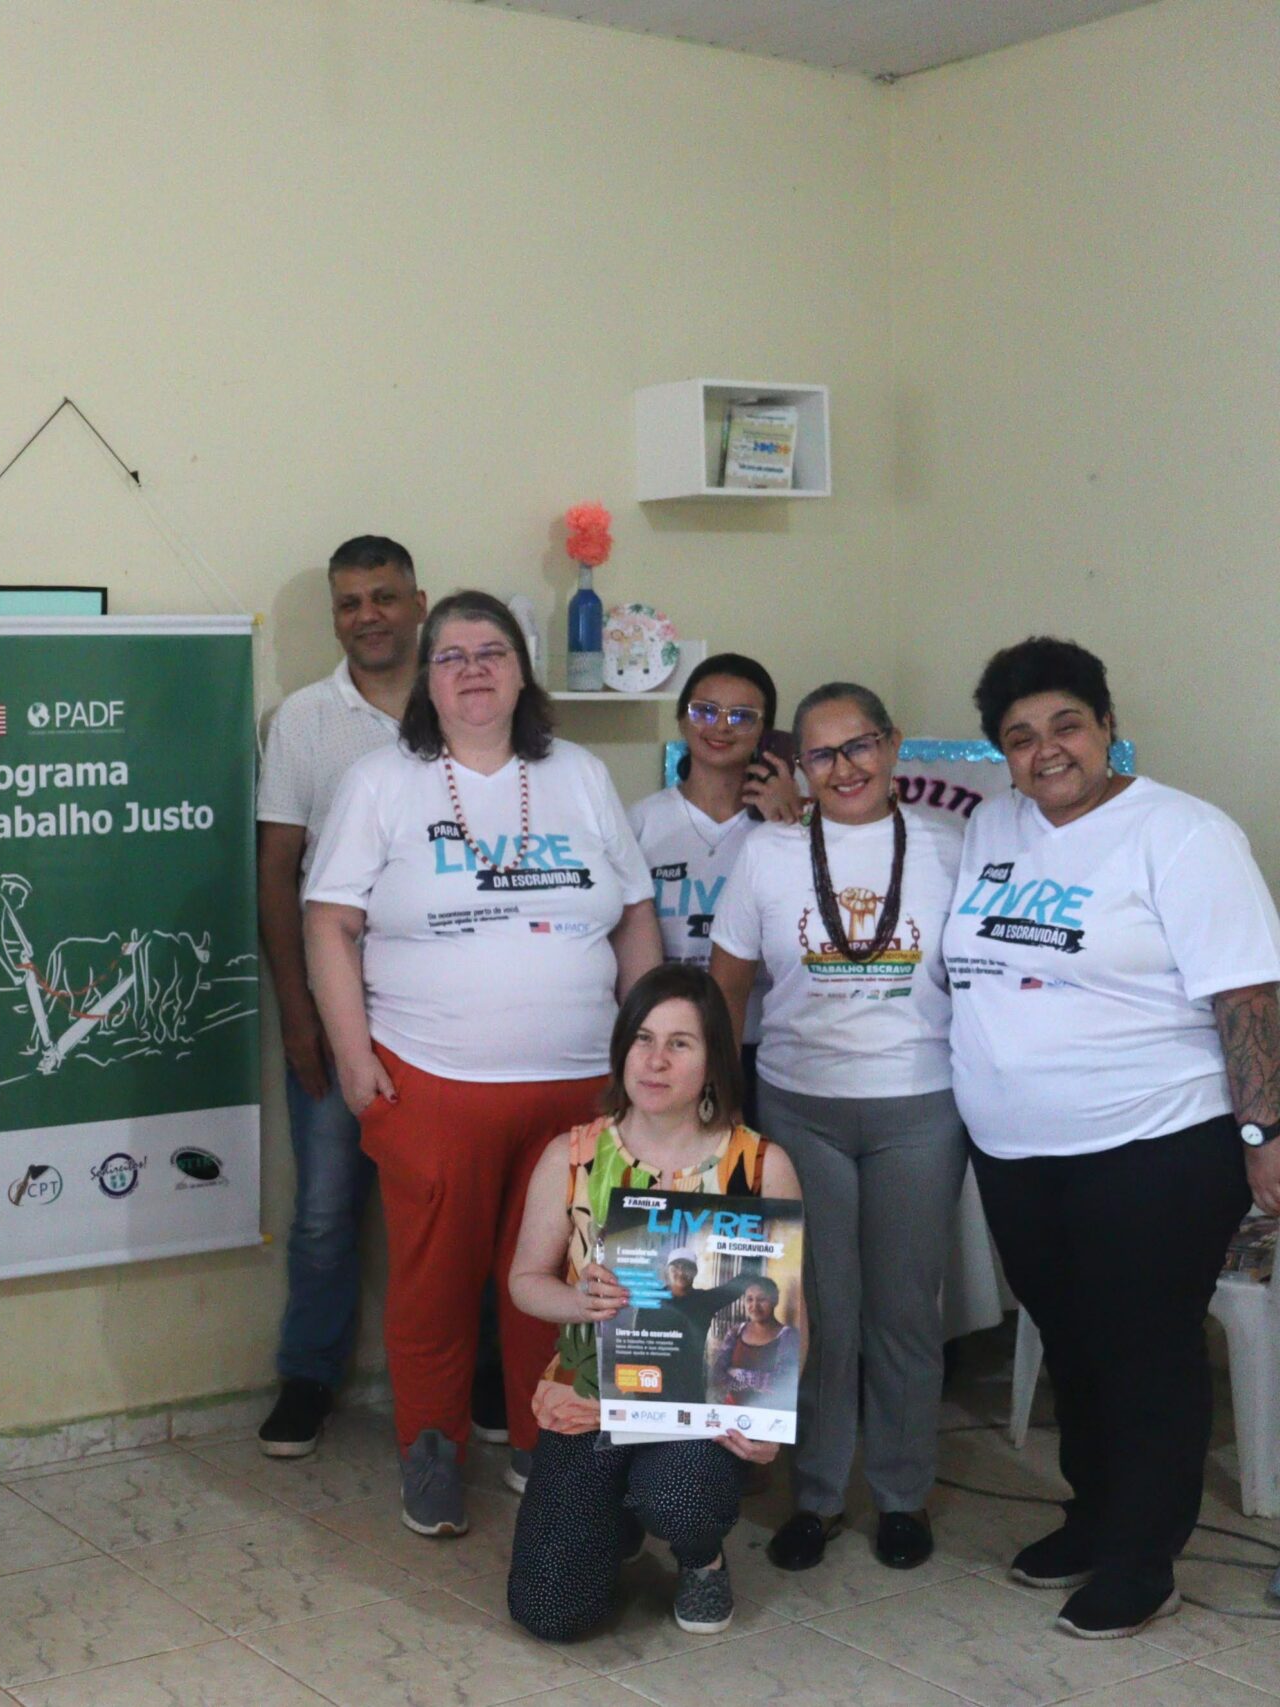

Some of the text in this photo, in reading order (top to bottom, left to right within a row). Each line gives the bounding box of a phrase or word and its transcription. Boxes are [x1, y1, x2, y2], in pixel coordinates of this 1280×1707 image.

[55, 700, 124, 728] PADF
[123, 800, 214, 834] Justo
[434, 833, 584, 874] LIVRE
[493, 870, 581, 888] DA ESCRAVIDÃO
[655, 875, 727, 917] LIV
[958, 879, 1094, 928] LIVRE
[991, 923, 1068, 946] DA ESCRAVIDÃO
[811, 964, 912, 974] TRABALHO ESCRAVO
[27, 1180, 58, 1198] CPT
[628, 1197, 661, 1208] FAMÍLIA
[647, 1207, 765, 1241] LIVRE
[717, 1241, 774, 1254] DA ESCRAVIDÃO
[640, 1377, 658, 1388] 100
